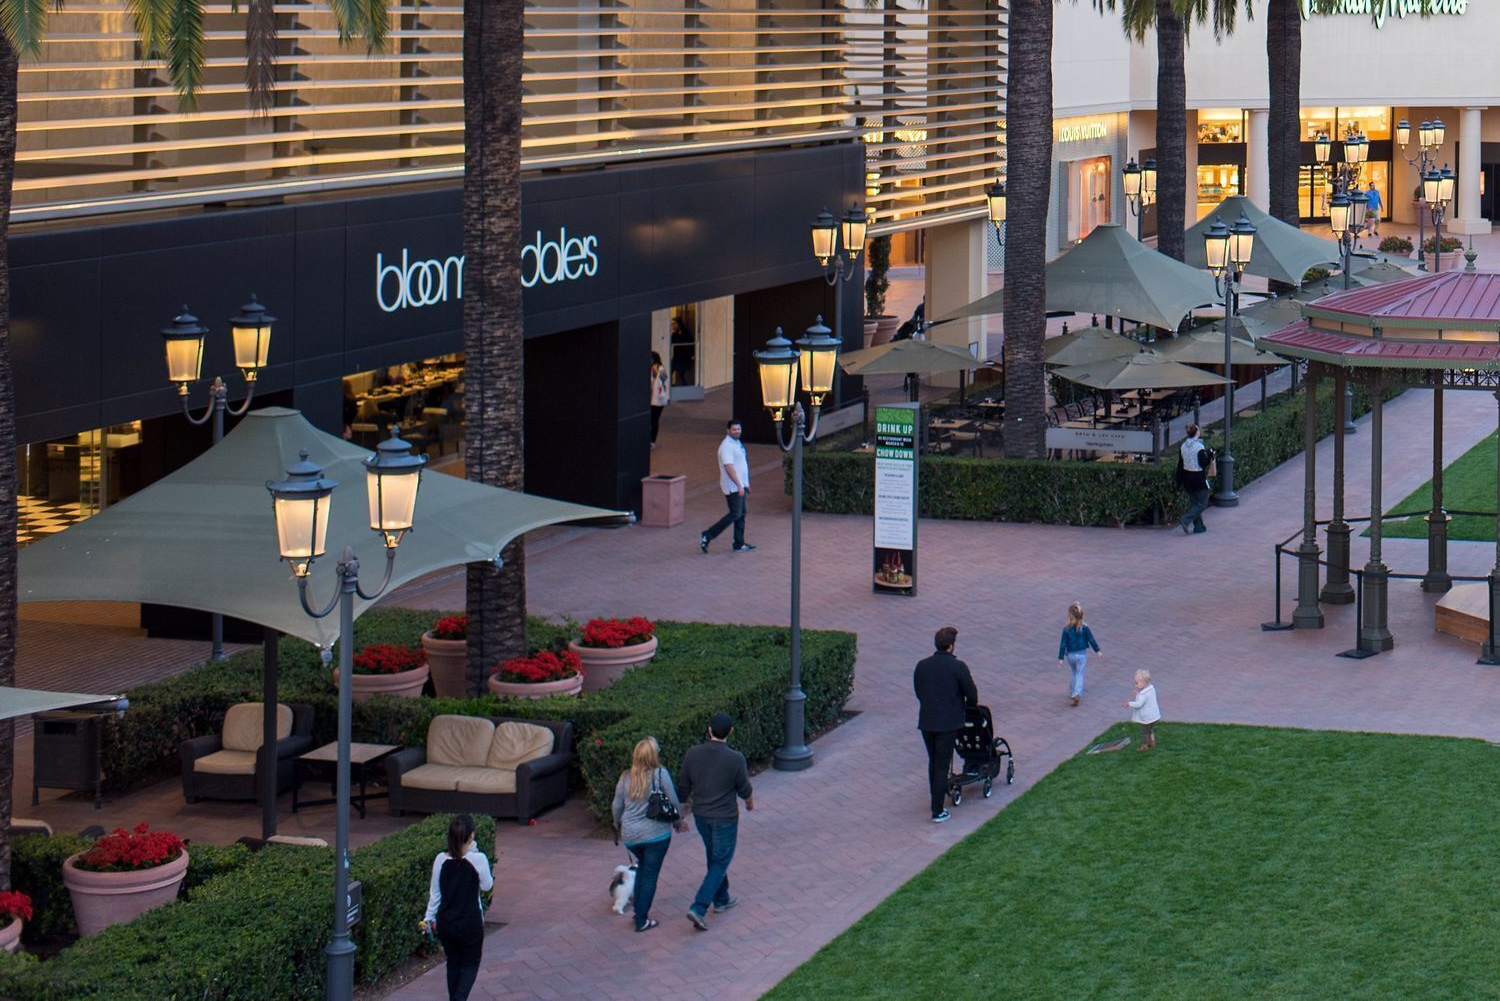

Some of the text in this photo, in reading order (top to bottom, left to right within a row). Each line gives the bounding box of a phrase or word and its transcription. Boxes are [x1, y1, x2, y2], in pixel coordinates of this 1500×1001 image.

[877, 423, 912, 434] DRINK UP
[877, 448, 913, 458] CHOW DOWN
